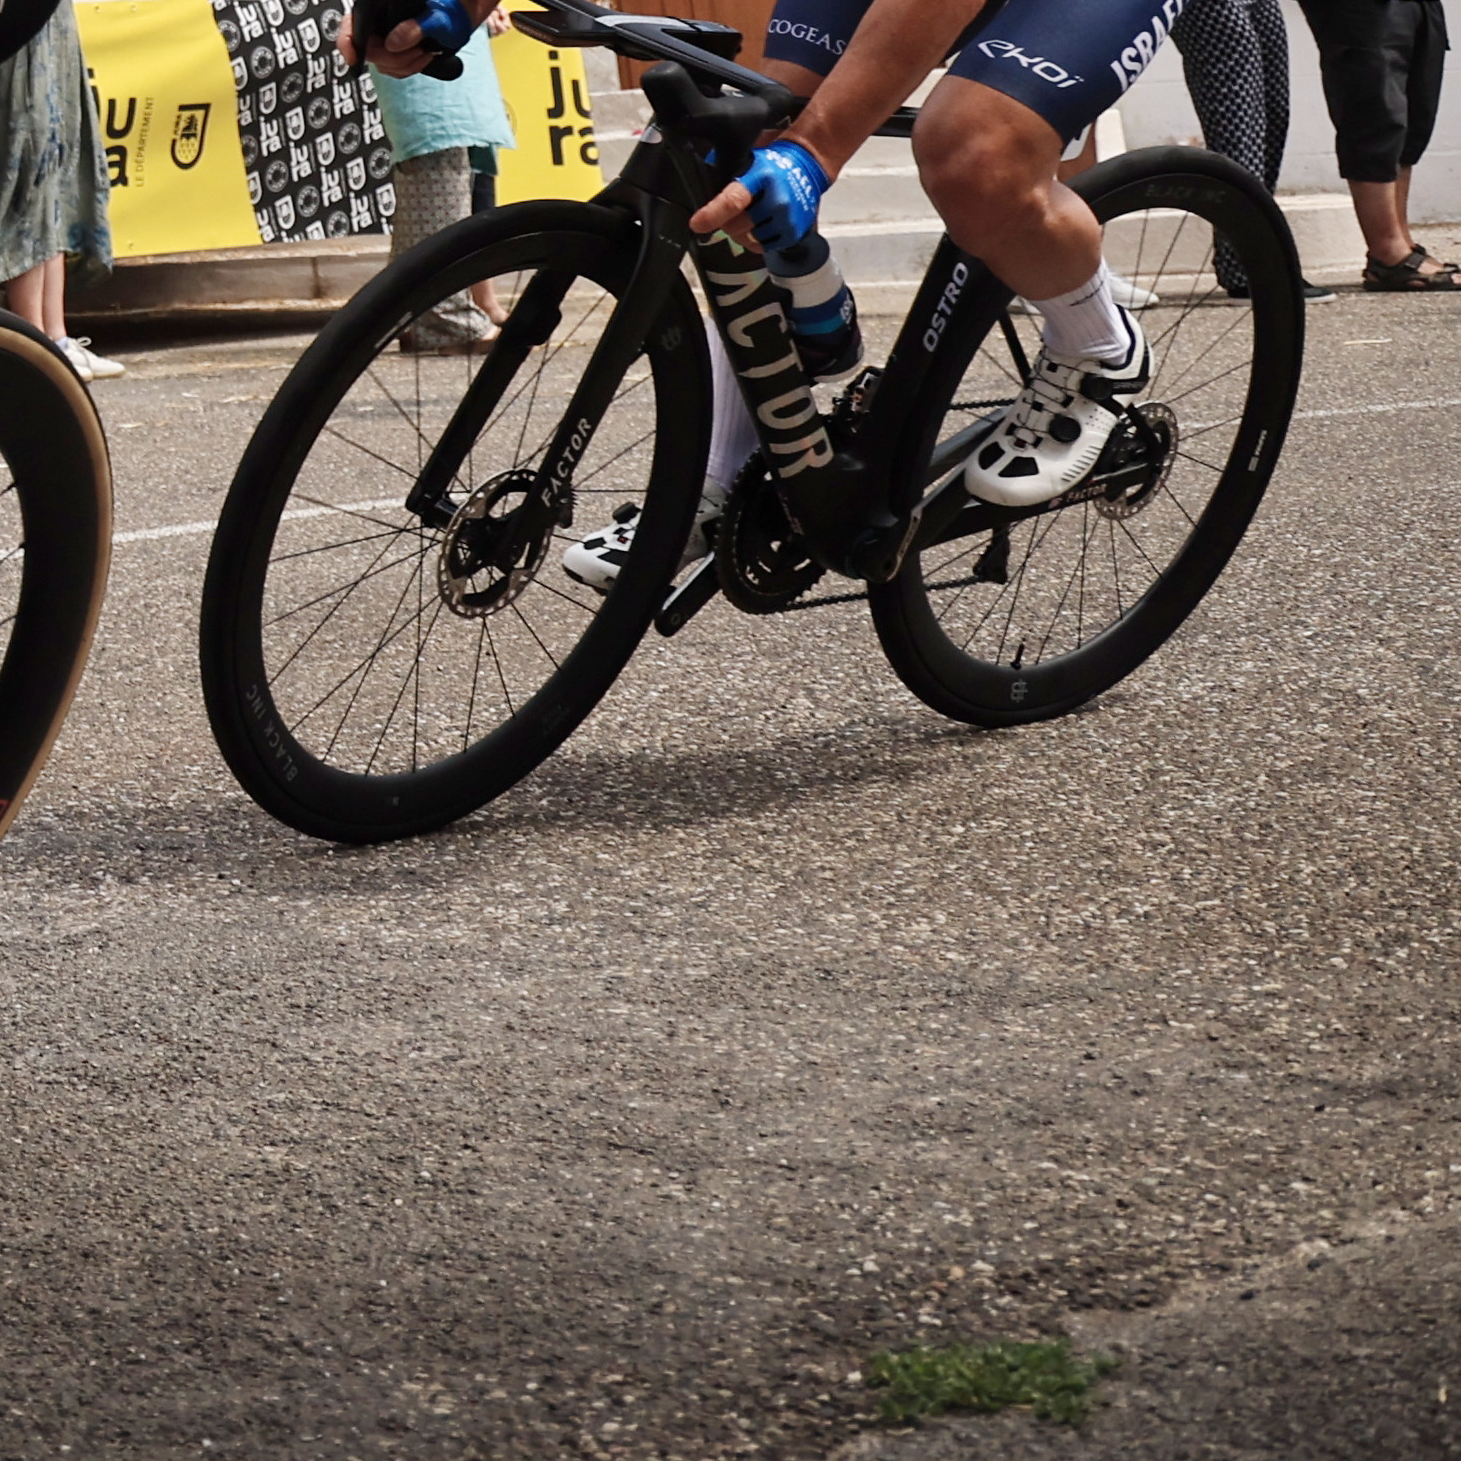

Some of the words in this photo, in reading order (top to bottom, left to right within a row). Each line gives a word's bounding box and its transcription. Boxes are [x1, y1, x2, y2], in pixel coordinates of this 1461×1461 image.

[270, 27, 293, 53] ju
[767, 17, 847, 58] COGEAS
[276, 48, 299, 69] ra
[332, 79, 352, 104] ju
[334, 98, 355, 119] ra
[320, 166, 340, 191] ju
[322, 187, 344, 207] ra
[922, 260, 970, 354] OSTRO
[540, 417, 594, 510] FACTOR
